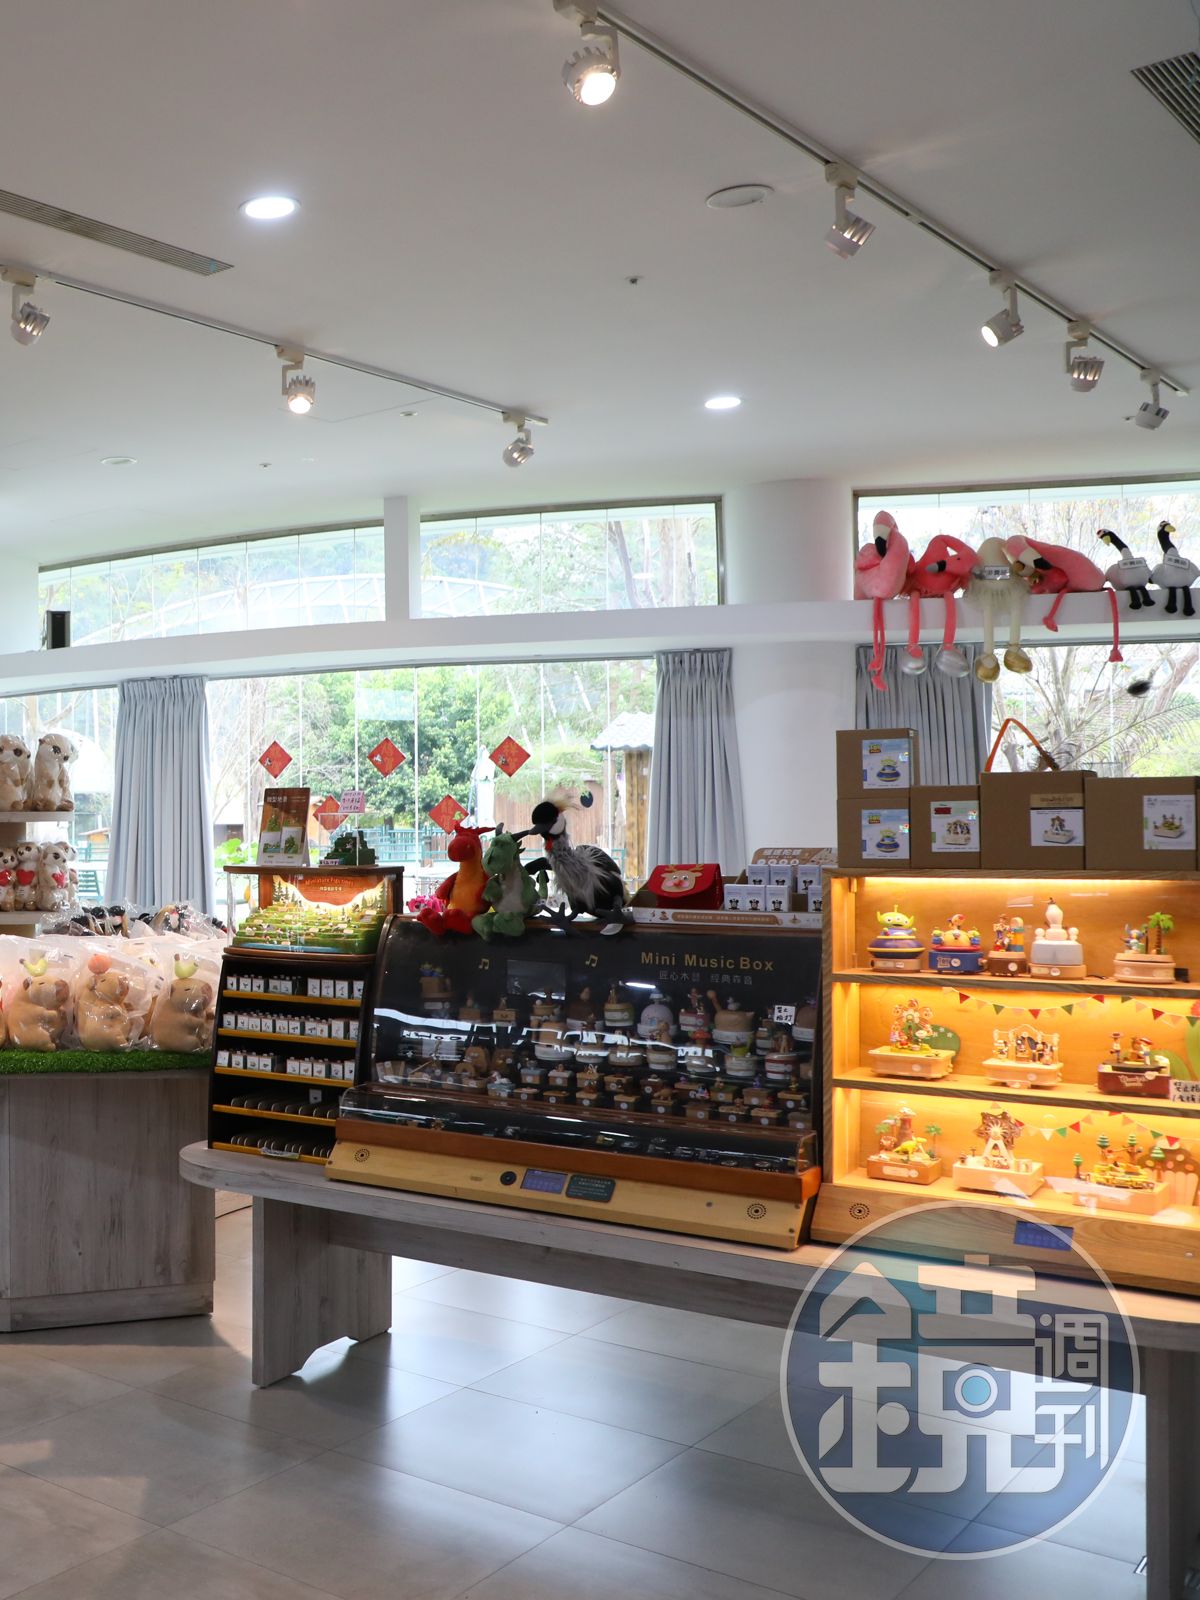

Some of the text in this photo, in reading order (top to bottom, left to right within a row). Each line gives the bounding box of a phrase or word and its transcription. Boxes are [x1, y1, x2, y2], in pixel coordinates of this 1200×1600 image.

[640, 952, 774, 971] Mini Music Box
